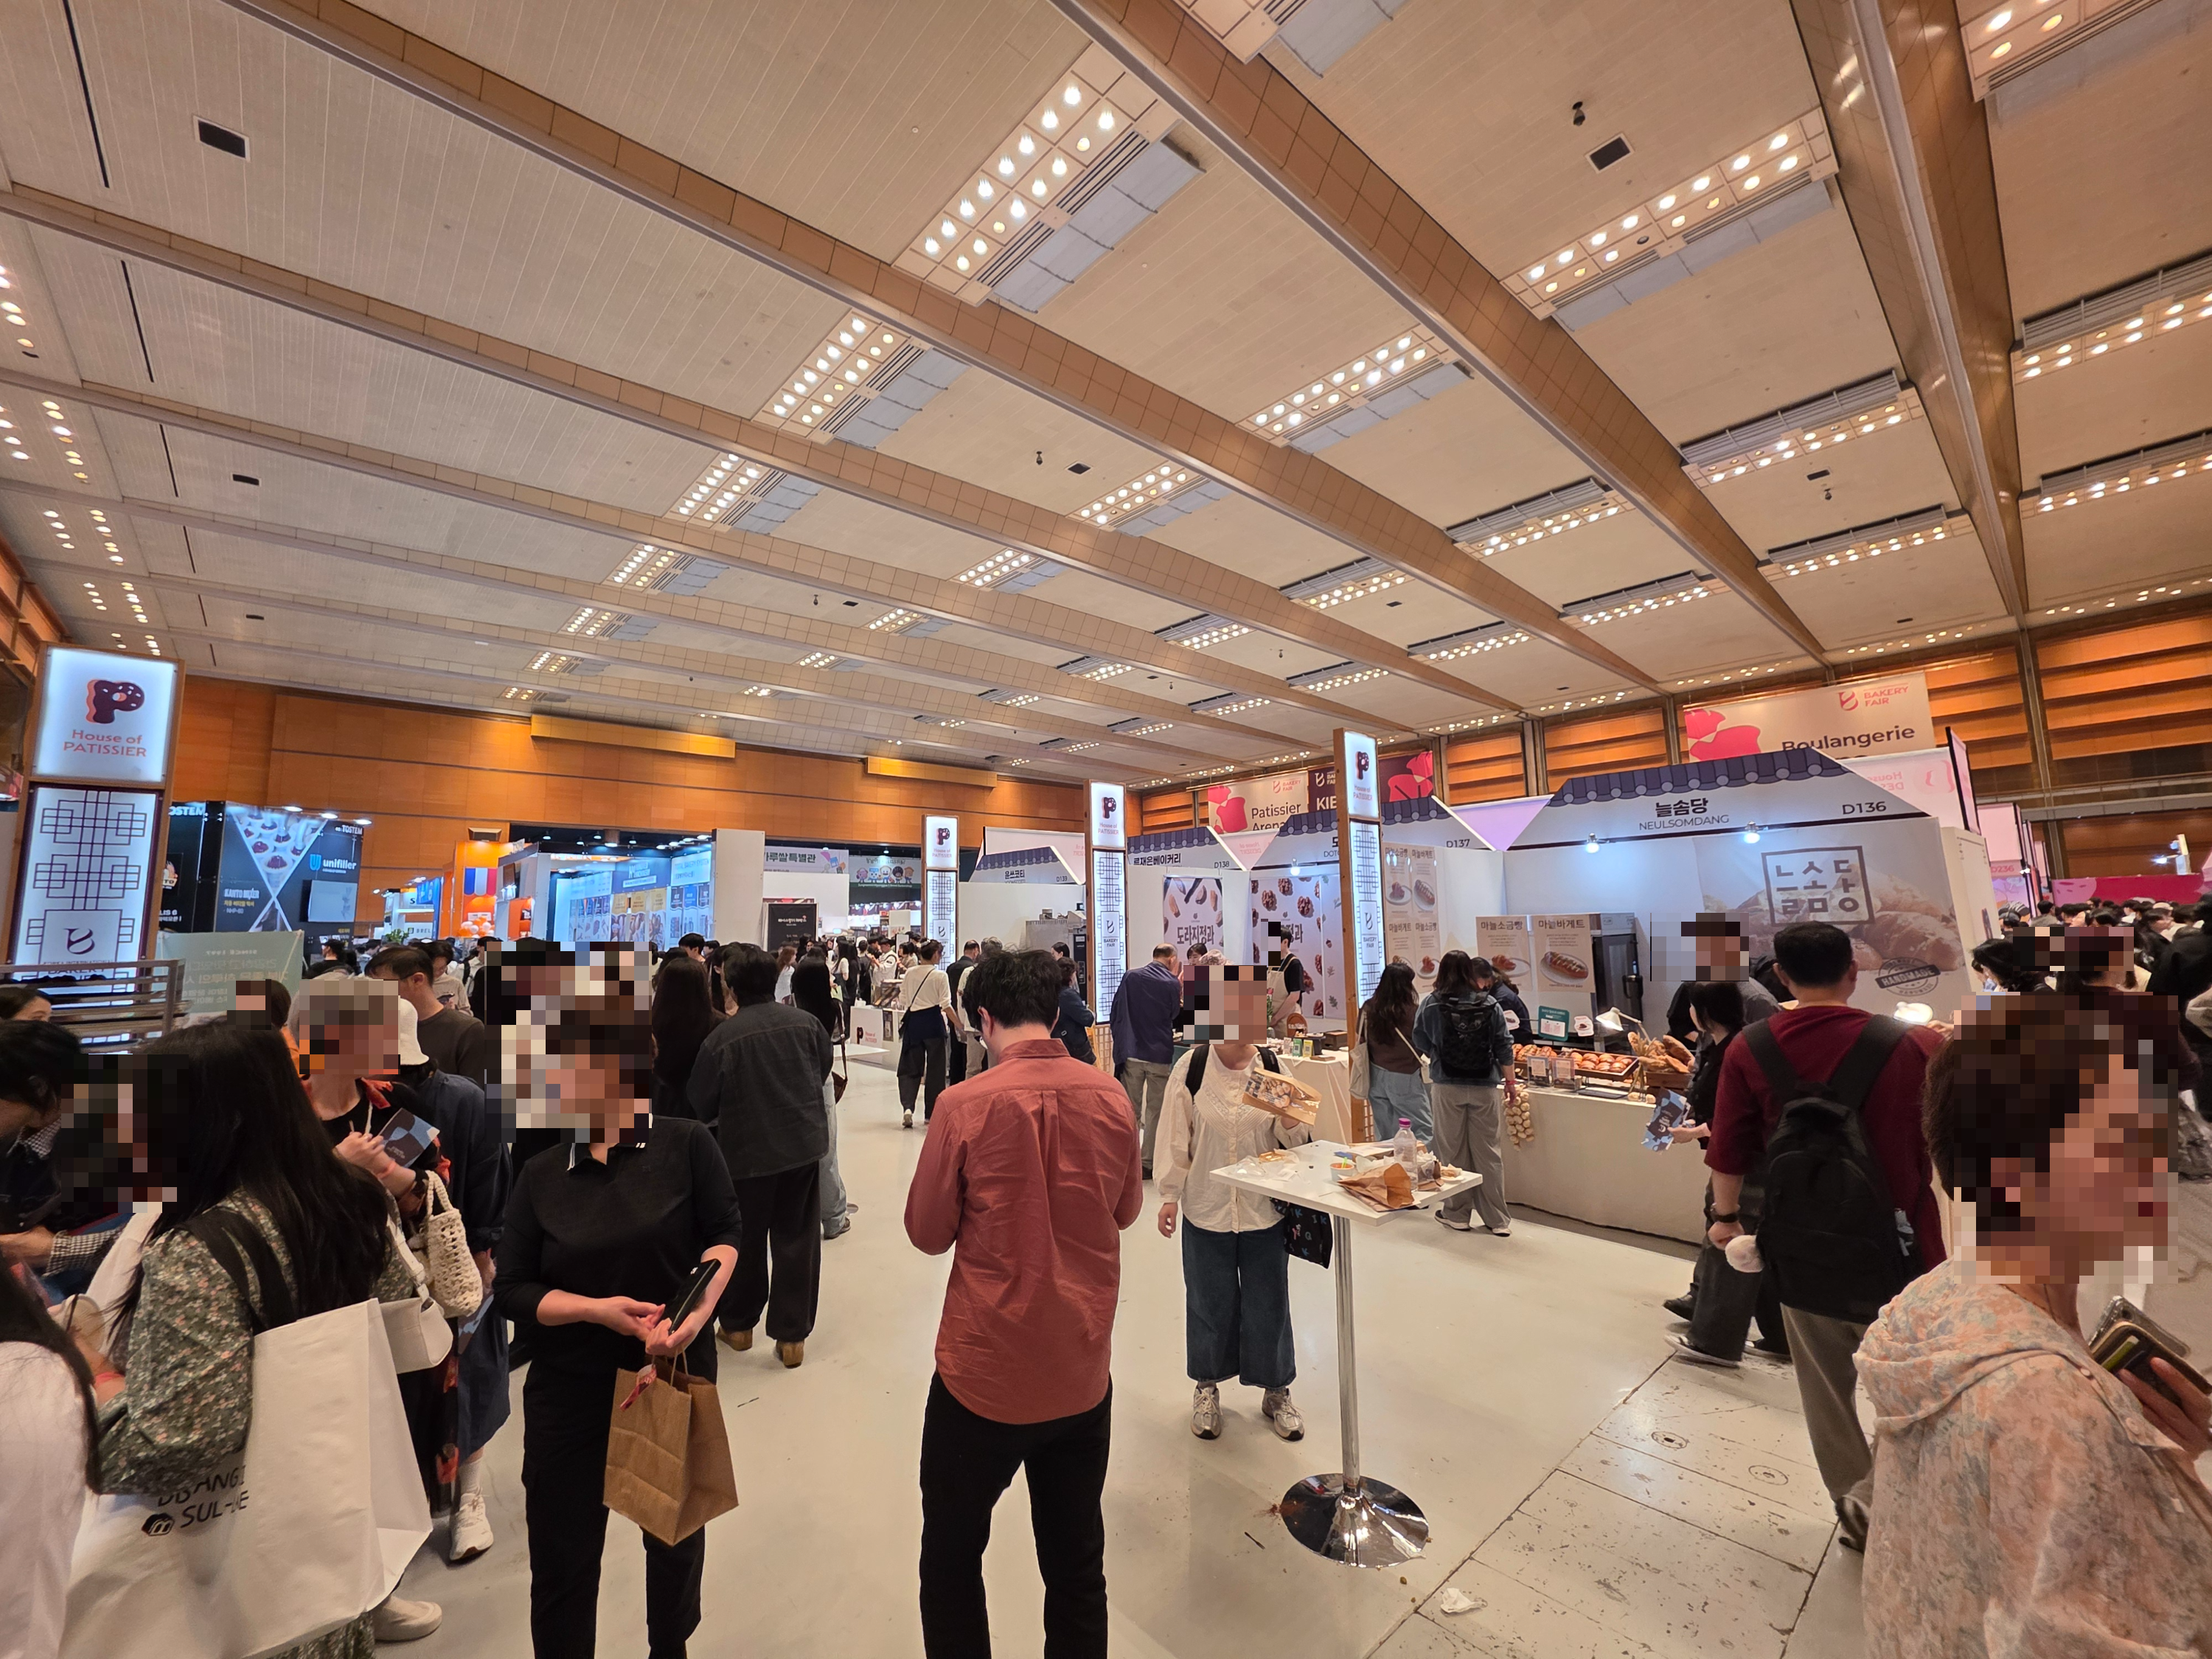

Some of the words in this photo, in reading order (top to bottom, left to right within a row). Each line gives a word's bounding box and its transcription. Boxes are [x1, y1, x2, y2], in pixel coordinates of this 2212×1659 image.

[1864, 686, 1909, 699] BAKERY
[1865, 697, 1890, 707] FAIR
[72, 729, 122, 742] House
[125, 734, 142, 744] of
[63, 742, 147, 757] PATISSIER
[1251, 801, 1301, 819] Patissier
[1655, 797, 1709, 818] 늘솜당
[1842, 801, 1887, 815] D136
[1639, 814, 1730, 831] NEULSOMDANG
[1446, 838, 1470, 848] D137
[323, 858, 357, 870] unifiller
[1214, 860, 1230, 869] D138
[1991, 864, 2014, 873] D236
[1388, 922, 1412, 933] 마늘바게트
[1415, 922, 1437, 932] 마늘소금빵
[1481, 920, 1523, 931] 마늘소금빵
[1538, 919, 1585, 930] 마늘바게트
[1177, 925, 1215, 945] 도라지정과
[1881, 967, 1935, 987] HANDMADE
